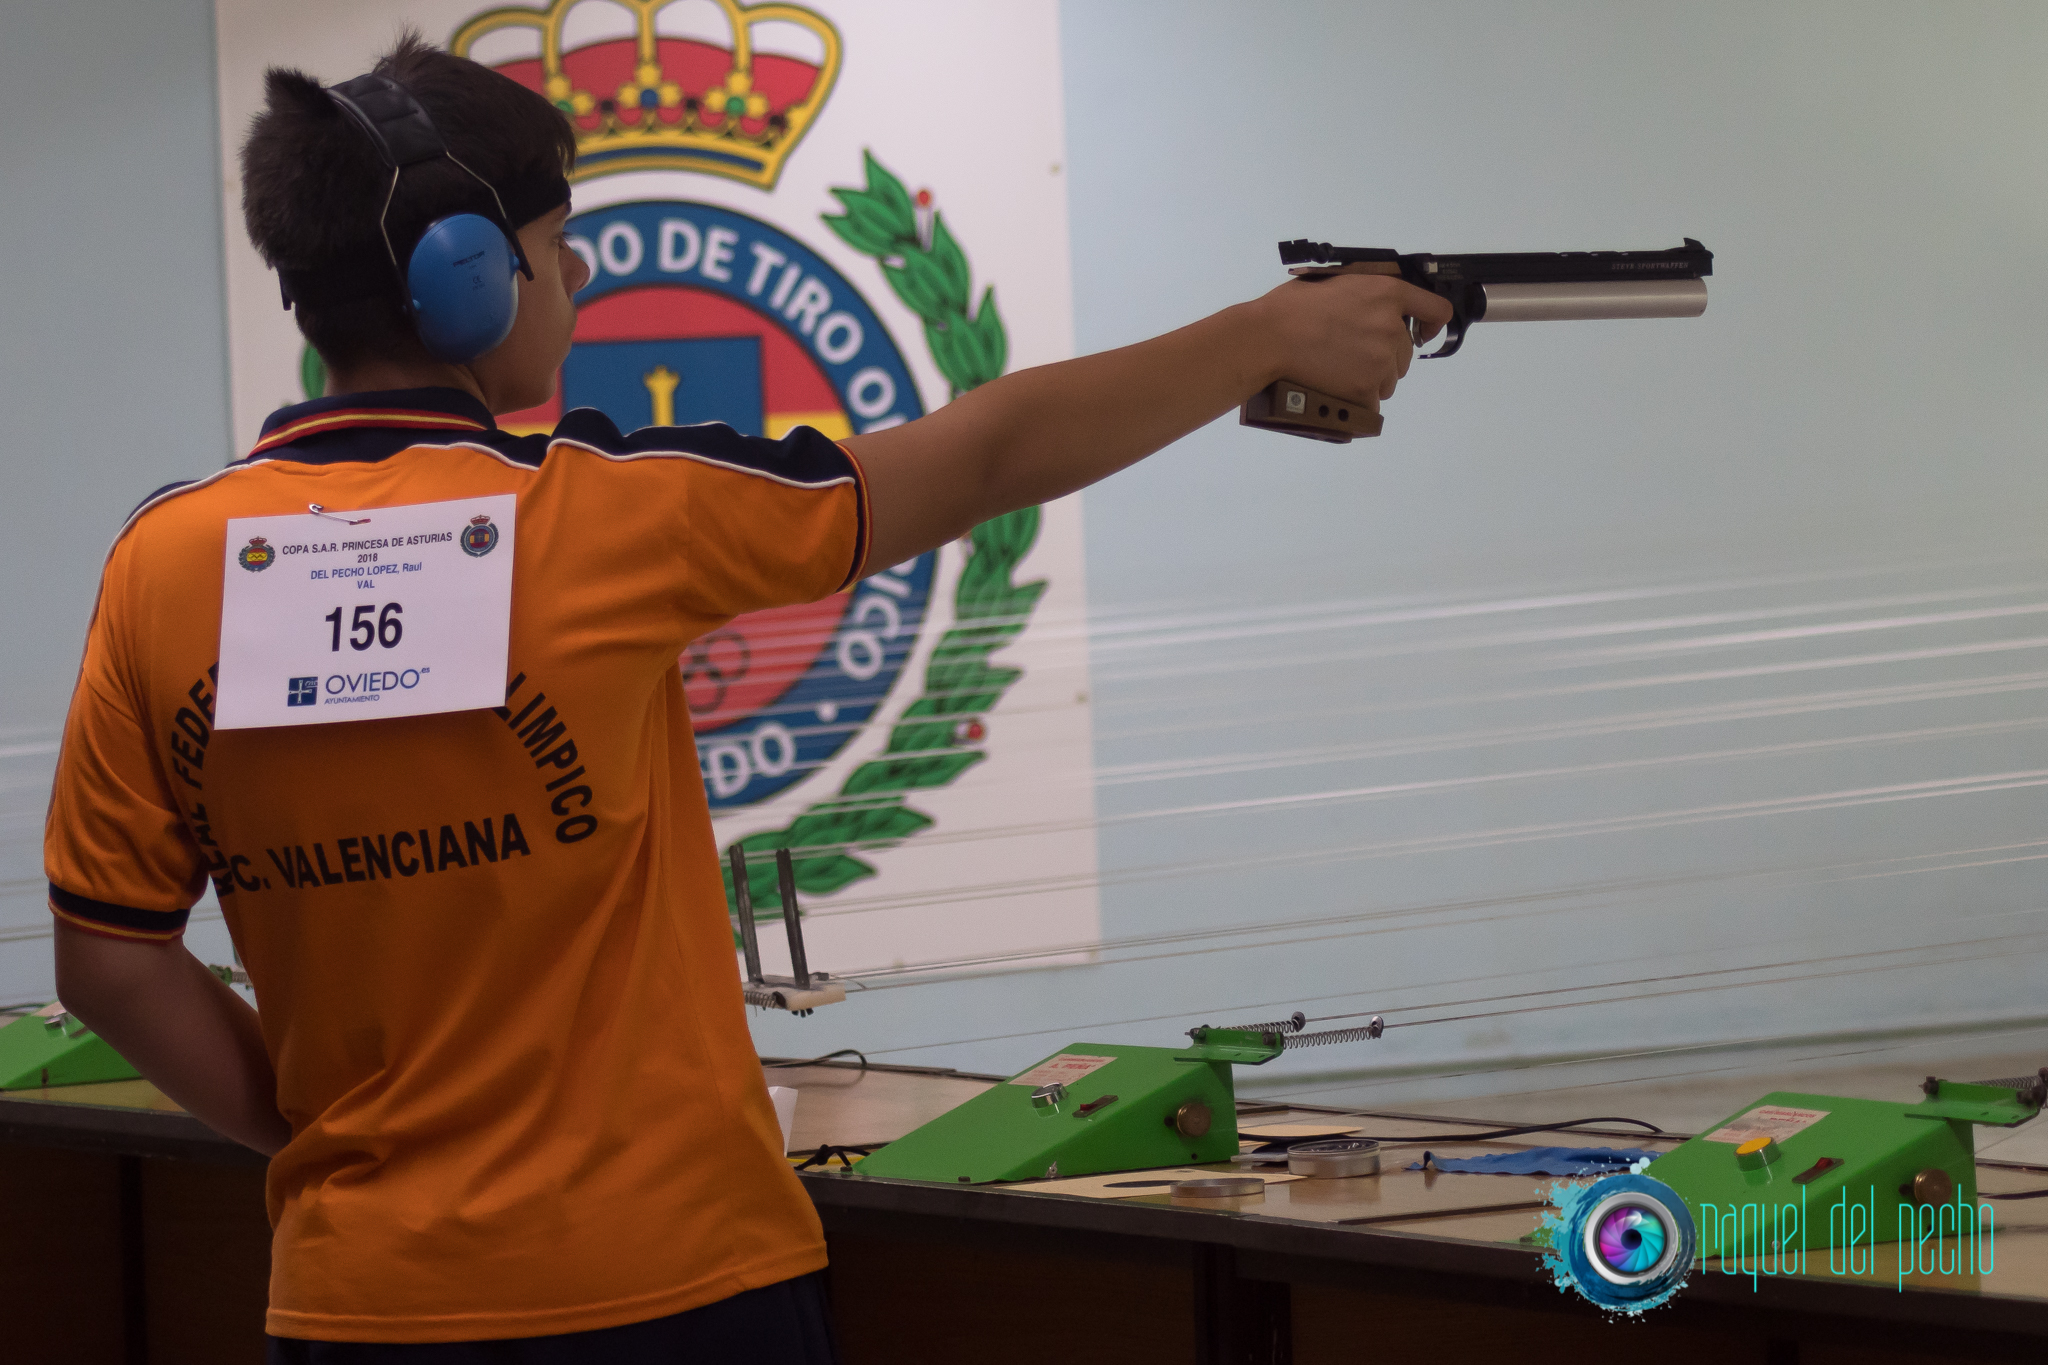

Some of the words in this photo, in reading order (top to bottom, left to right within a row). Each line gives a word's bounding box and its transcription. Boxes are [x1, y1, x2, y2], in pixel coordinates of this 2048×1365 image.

[656, 217, 739, 283] DE
[746, 241, 865, 365] TIRO
[282, 544, 310, 556] COPA
[311, 542, 339, 554] S.A.R.
[341, 538, 389, 552] PRINCESA
[391, 536, 404, 548] DE
[406, 531, 453, 546] ASTURIAS
[357, 552, 378, 564] 2018
[310, 569, 330, 581] DEL
[332, 566, 365, 579] PECHO
[367, 564, 400, 577] LOPEZ,
[402, 561, 422, 573] Raul
[357, 579, 376, 590] VAL
[325, 602, 404, 652] 156
[324, 693, 381, 706] AYUNTAMIENTO
[492, 671, 598, 844] LIMPICO
[266, 813, 531, 889] VALENCIANA
